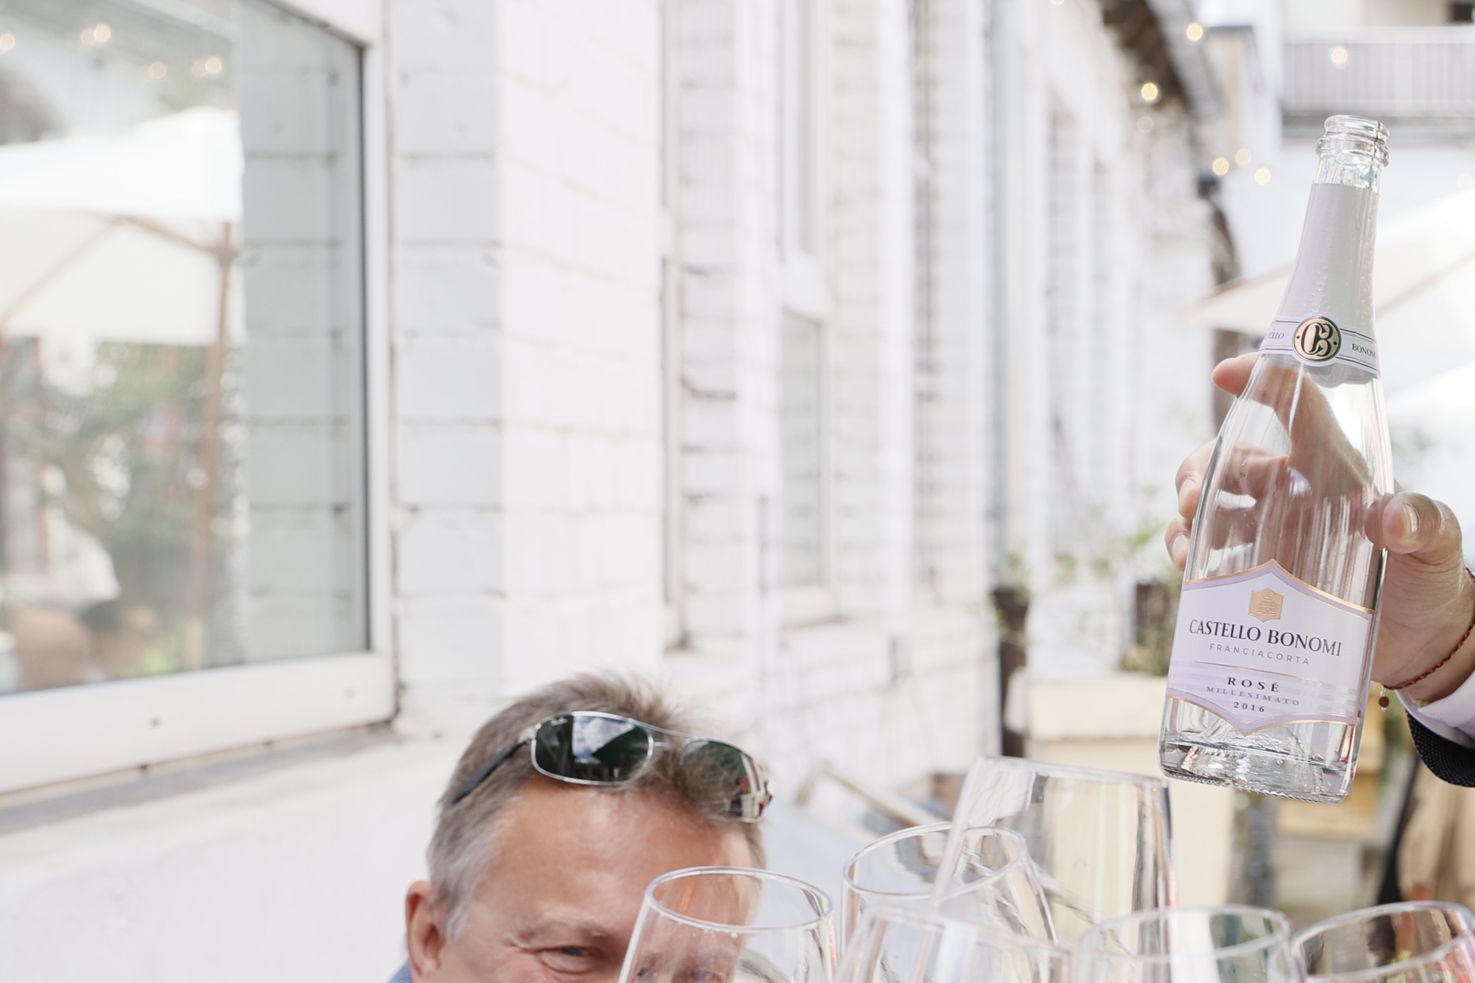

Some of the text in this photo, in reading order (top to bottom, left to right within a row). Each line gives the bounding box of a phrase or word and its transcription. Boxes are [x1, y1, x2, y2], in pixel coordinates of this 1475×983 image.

[1189, 618, 1342, 657] CASTELLO BONOMI
[1208, 642, 1310, 665] FRANCIACORTA
[1227, 676, 1281, 694] ROSÉ
[1206, 686, 1300, 706] MILLESIMATO
[1232, 701, 1266, 713] 2016
